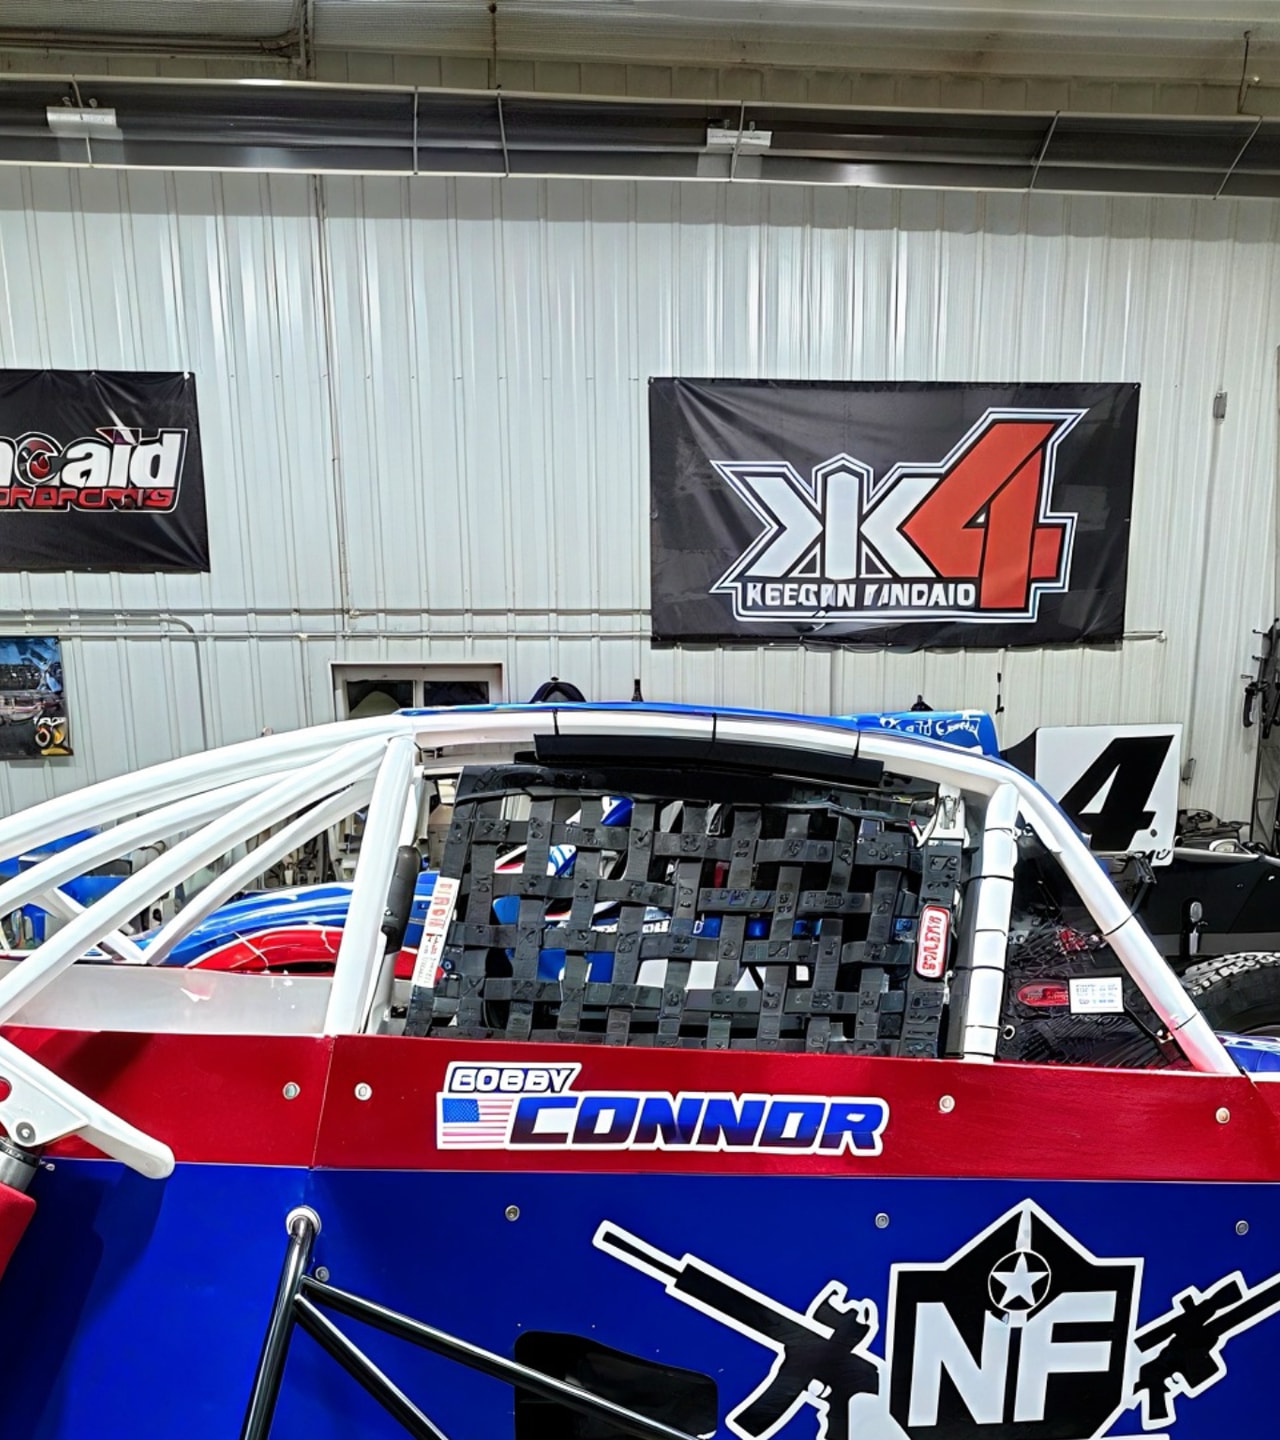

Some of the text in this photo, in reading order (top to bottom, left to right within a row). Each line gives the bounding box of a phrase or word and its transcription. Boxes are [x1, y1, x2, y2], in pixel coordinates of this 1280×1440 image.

[1058, 735, 1175, 852] 4
[509, 1096, 884, 1150] CONNOR
[908, 1290, 1117, 1427] NF
